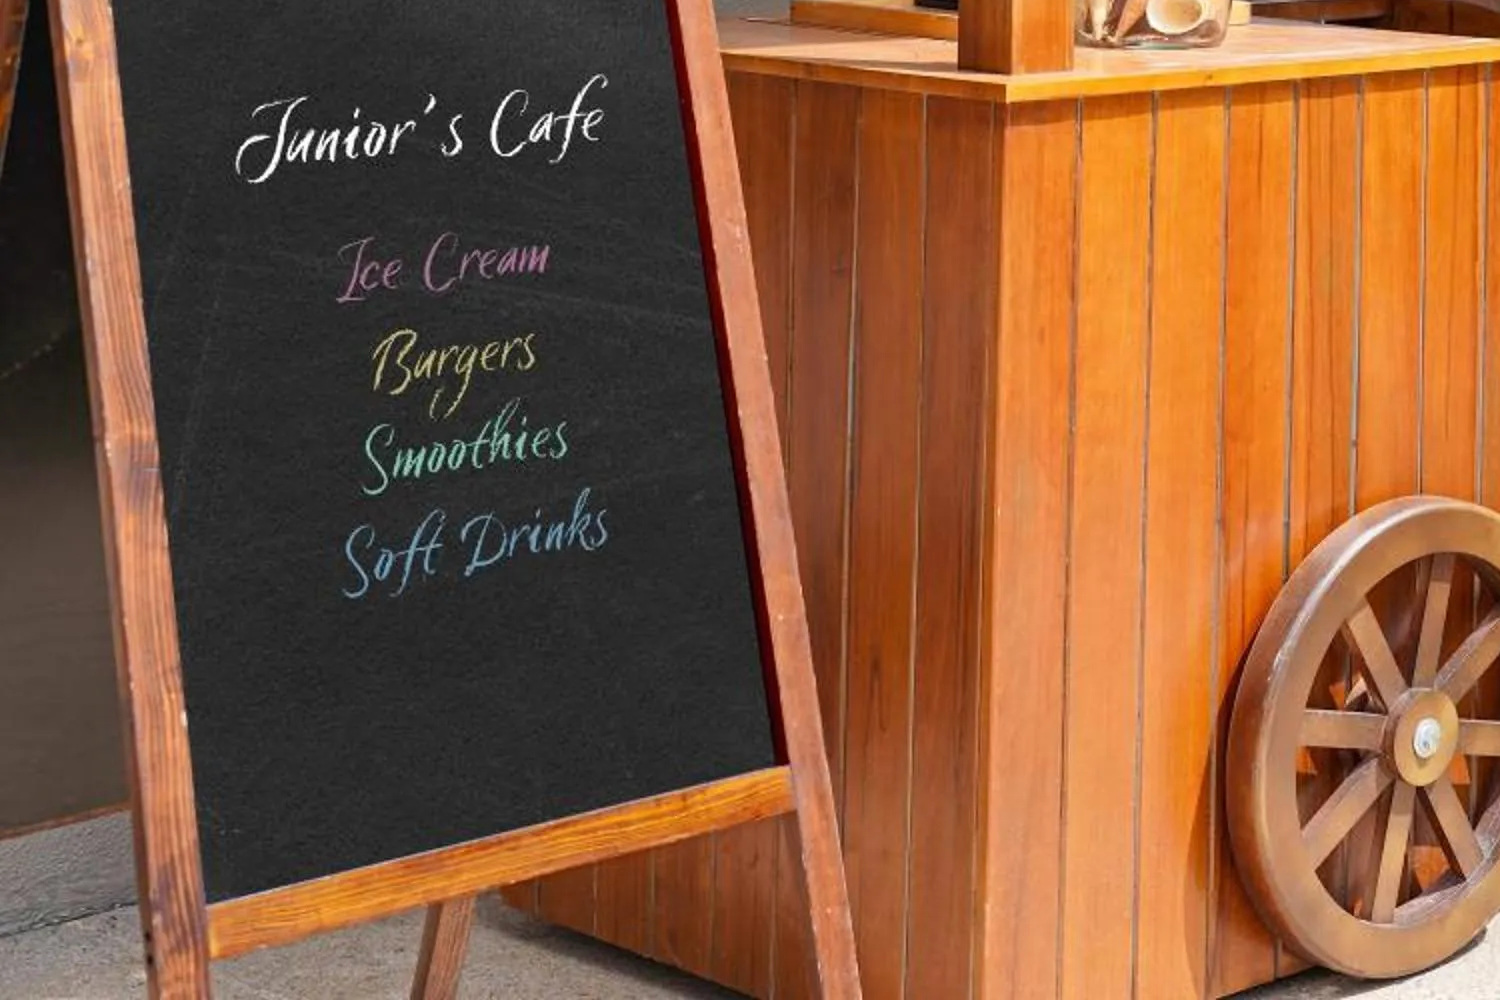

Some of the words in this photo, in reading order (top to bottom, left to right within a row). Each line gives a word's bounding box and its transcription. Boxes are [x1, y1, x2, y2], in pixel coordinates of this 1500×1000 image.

[235, 93, 463, 184] Junior's
[489, 73, 608, 164] Cafe
[335, 236, 402, 304] Ice
[423, 231, 551, 293] Cream
[370, 328, 536, 422] Burgers
[362, 397, 568, 495] Smoothies
[342, 508, 446, 599] Soft
[459, 486, 609, 577] Drinks
